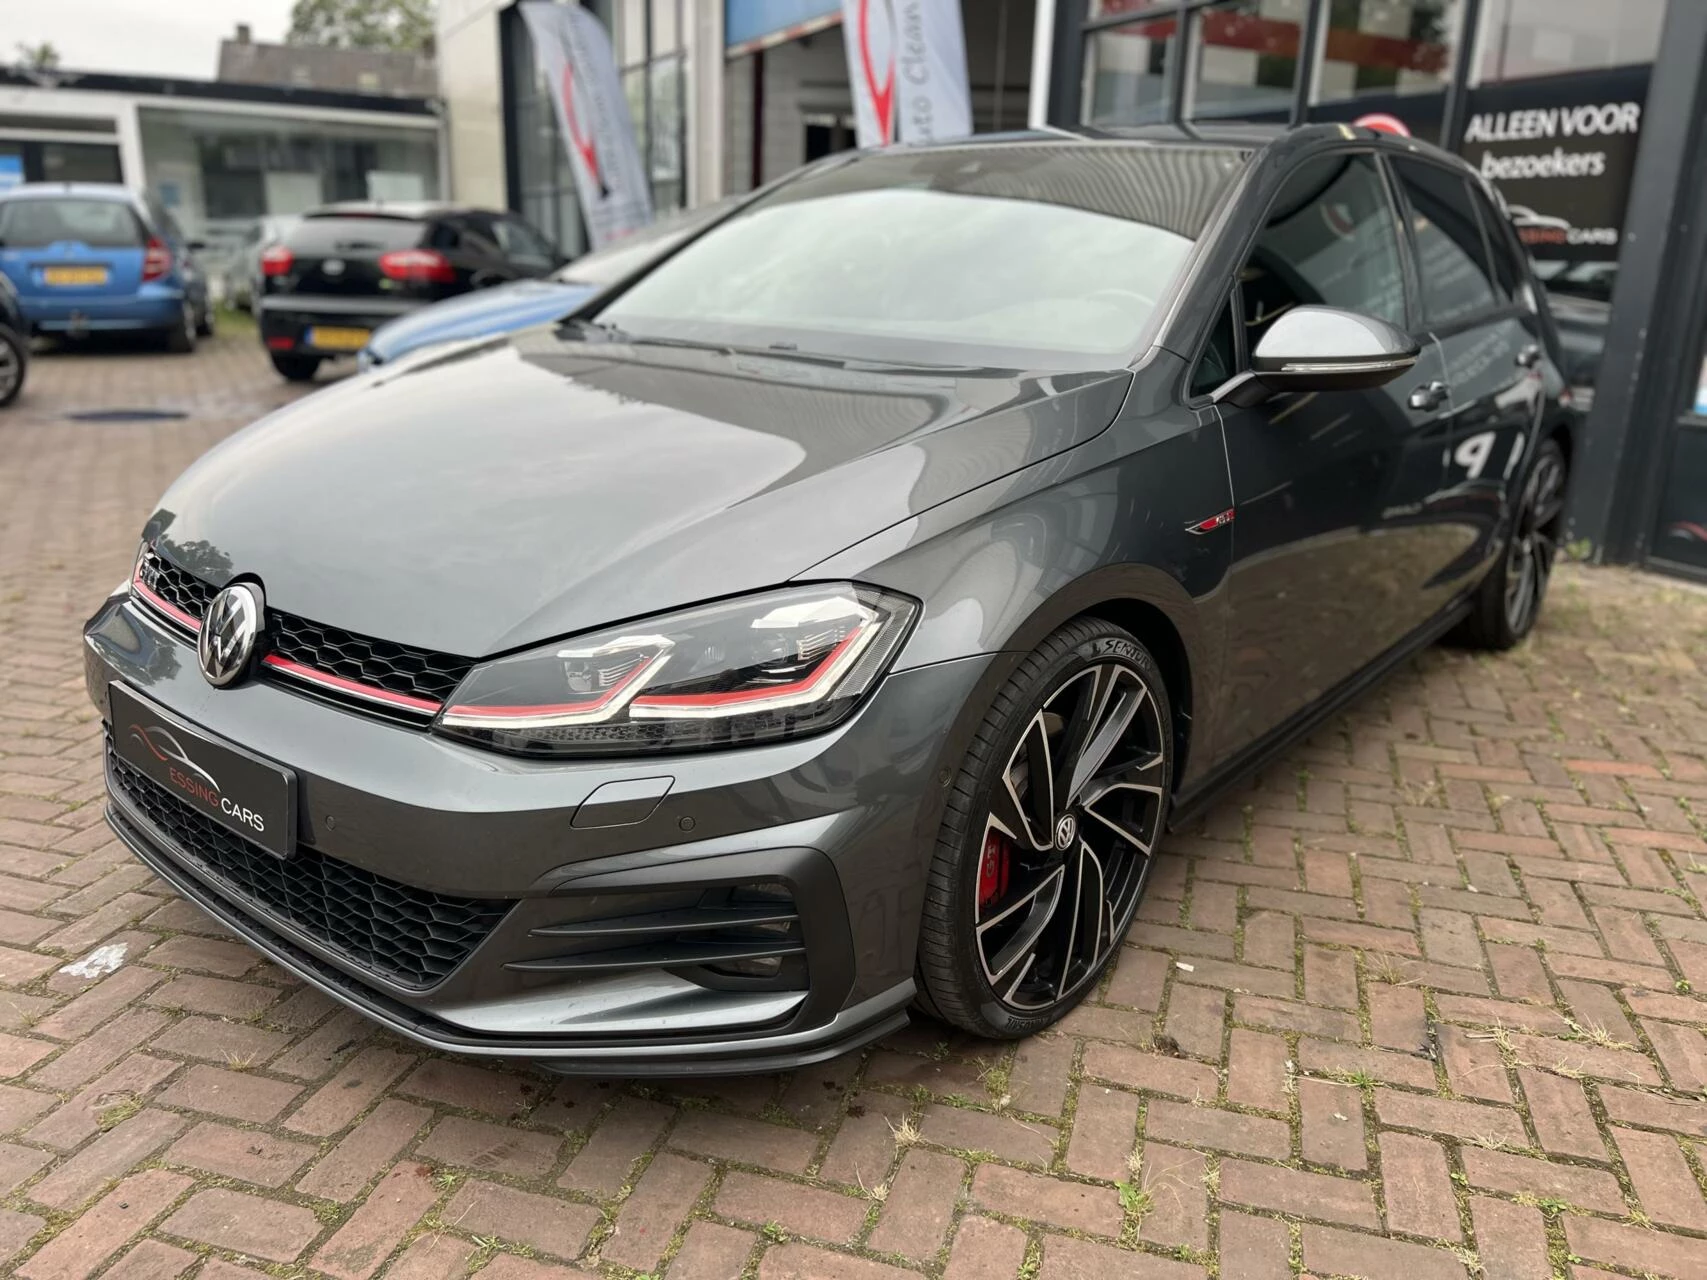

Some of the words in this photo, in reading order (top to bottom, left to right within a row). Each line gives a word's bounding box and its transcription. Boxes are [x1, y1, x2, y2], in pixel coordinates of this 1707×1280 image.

[1464, 108, 1559, 143] ALLEEN
[1559, 102, 1641, 137] VOOR
[1481, 147, 1606, 180] bezoekers
[1567, 227, 1618, 245] CARS
[169, 766, 220, 808] ESSING
[220, 797, 265, 832] CARS
